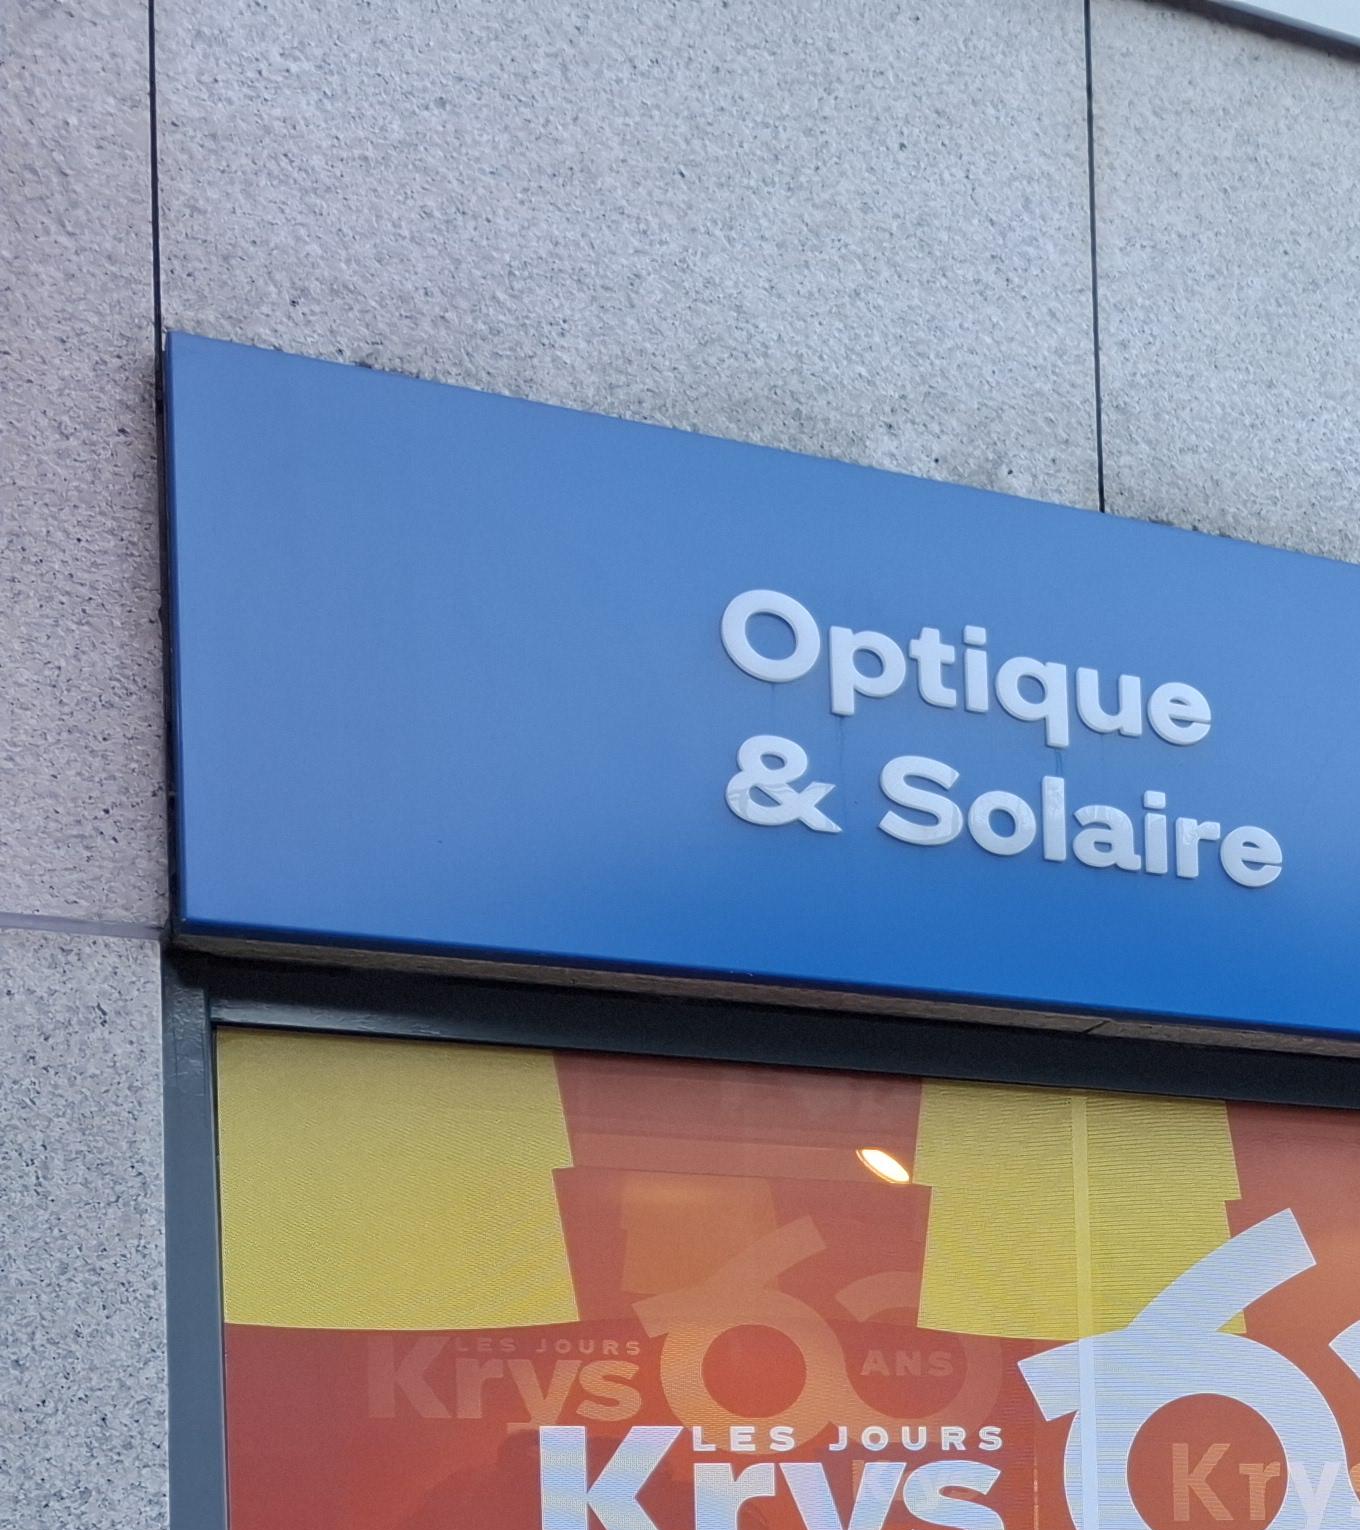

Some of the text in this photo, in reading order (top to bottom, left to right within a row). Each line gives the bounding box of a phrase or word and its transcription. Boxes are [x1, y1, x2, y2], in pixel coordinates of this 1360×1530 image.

[720, 589, 1212, 748] Optique
[725, 734, 1284, 887] & Solaire
[693, 1426, 1003, 1452] LES JOURS
